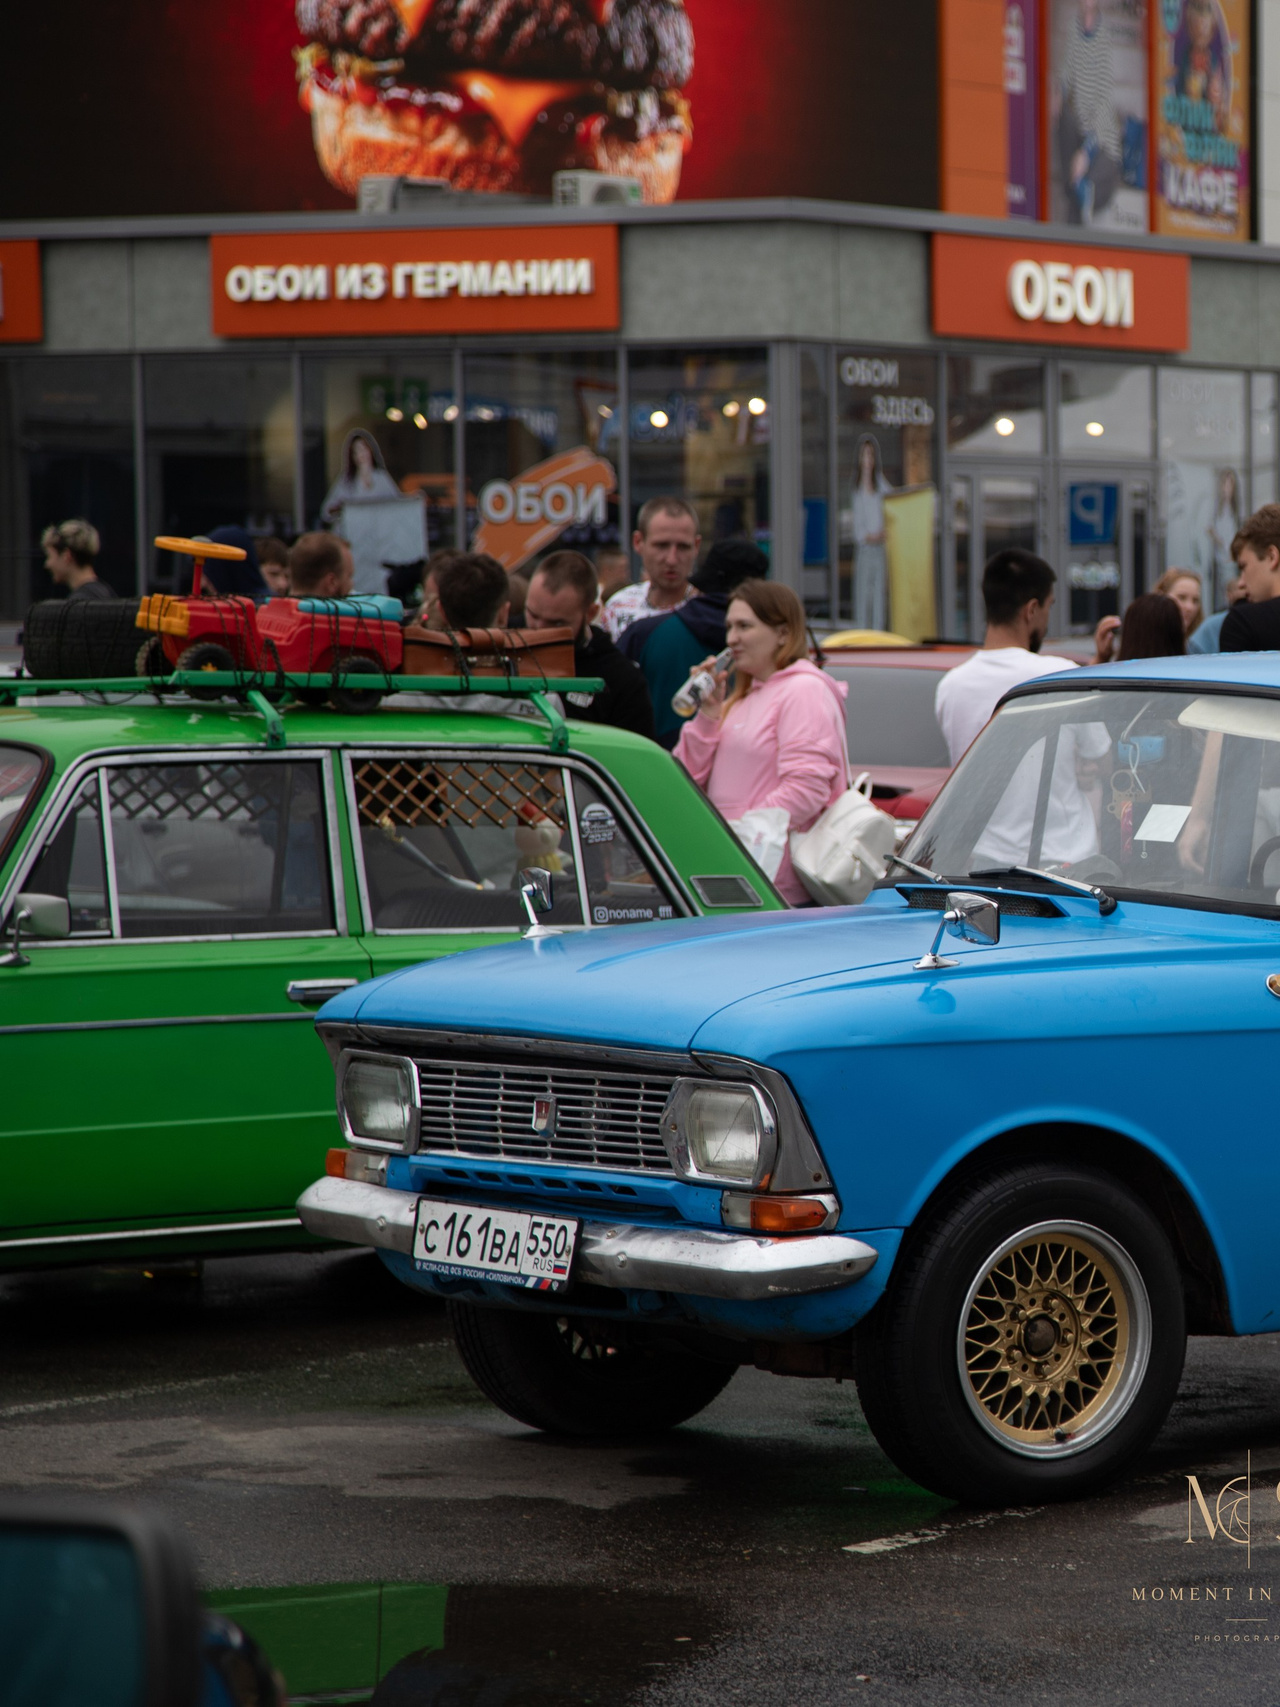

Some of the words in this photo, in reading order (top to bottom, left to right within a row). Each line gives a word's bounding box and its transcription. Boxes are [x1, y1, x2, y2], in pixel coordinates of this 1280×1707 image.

[1163, 162, 1238, 215] КАФЕ
[225, 264, 328, 303] ОБОИ
[334, 262, 386, 300] ИЗ
[392, 257, 593, 299] ГЕРМАНИИ
[1009, 258, 1135, 329] ОБОИ
[840, 356, 899, 389] ОБОИ
[479, 478, 608, 527] ОБОИ
[424, 1212, 521, 1267] С161ВА
[526, 1221, 568, 1259] 550
[421, 1261, 450, 1275] ЯСЛИ-САД
[450, 1265, 462, 1277] ФСБ
[462, 1267, 486, 1281] РОССИИ
[533, 1257, 553, 1273] RUS
